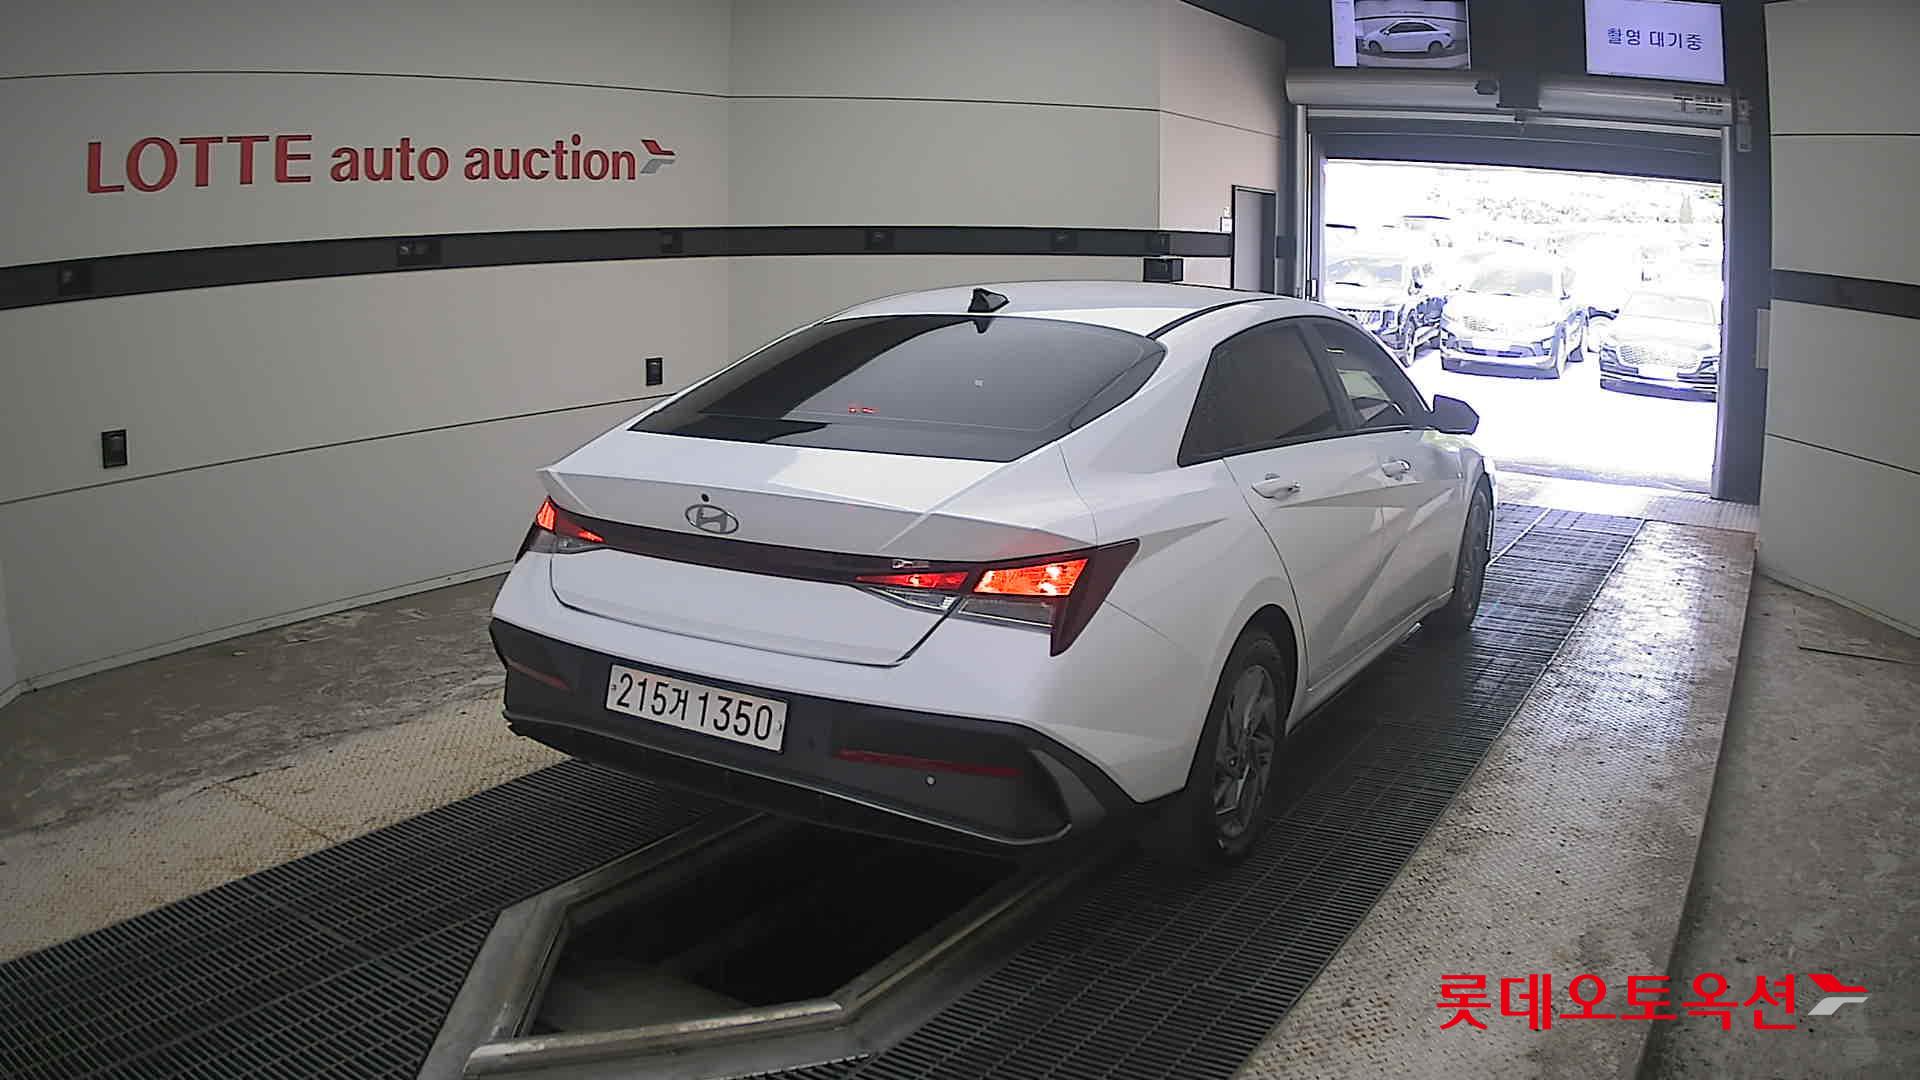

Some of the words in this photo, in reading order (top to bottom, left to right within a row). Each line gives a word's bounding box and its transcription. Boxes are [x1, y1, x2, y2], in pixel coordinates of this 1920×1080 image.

[1649, 31, 1702, 51] 대기중
[87, 134, 312, 194] LOTTE
[329, 137, 450, 182] auto
[463, 133, 637, 181] auction
